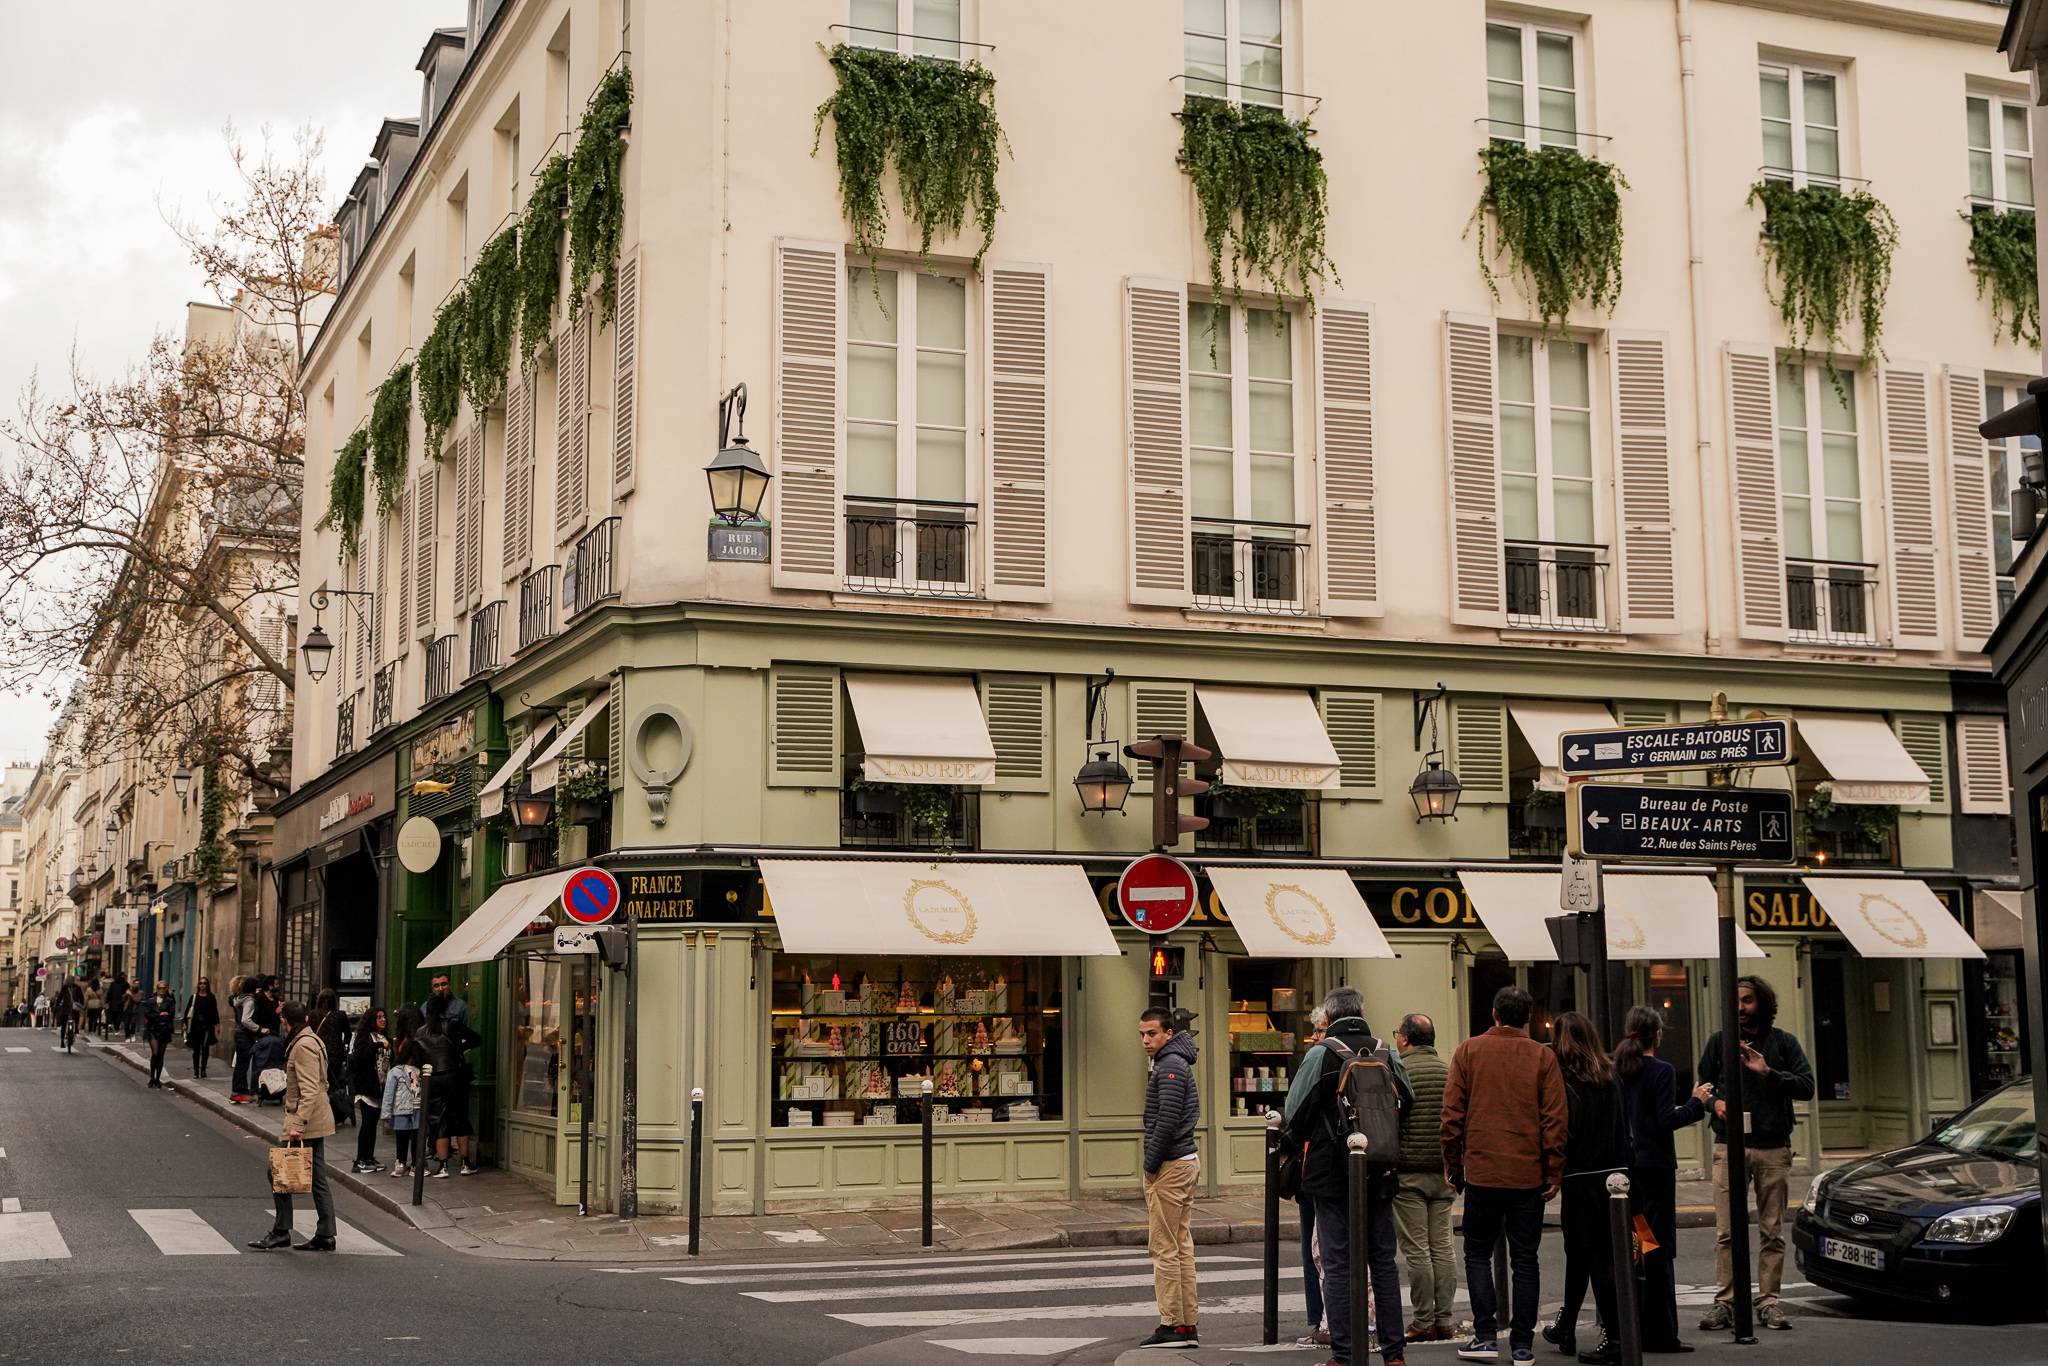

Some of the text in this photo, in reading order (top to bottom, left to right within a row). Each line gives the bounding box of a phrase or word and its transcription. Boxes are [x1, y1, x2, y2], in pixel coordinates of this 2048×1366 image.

[728, 533, 752, 543] RUE
[1627, 729, 1751, 749] ESCALE-BATOBUS
[1649, 749, 1697, 762] GERMAIN
[1700, 750, 1717, 760] DES
[1721, 744, 1748, 758] PRÉS
[1640, 796, 1749, 813] Bureau de Poste
[1659, 838, 1678, 849] Rue
[1679, 839, 1697, 850] des
[1698, 839, 1728, 851] Saints
[1730, 840, 1757, 851] Pères
[631, 875, 682, 894] FRANCE
[621, 900, 694, 918] BONAPARTE
[1750, 892, 1836, 927] SALO
[887, 1022, 920, 1041] 160
[887, 1041, 922, 1053] ans
[1826, 1241, 1876, 1267] GF-288-HE
